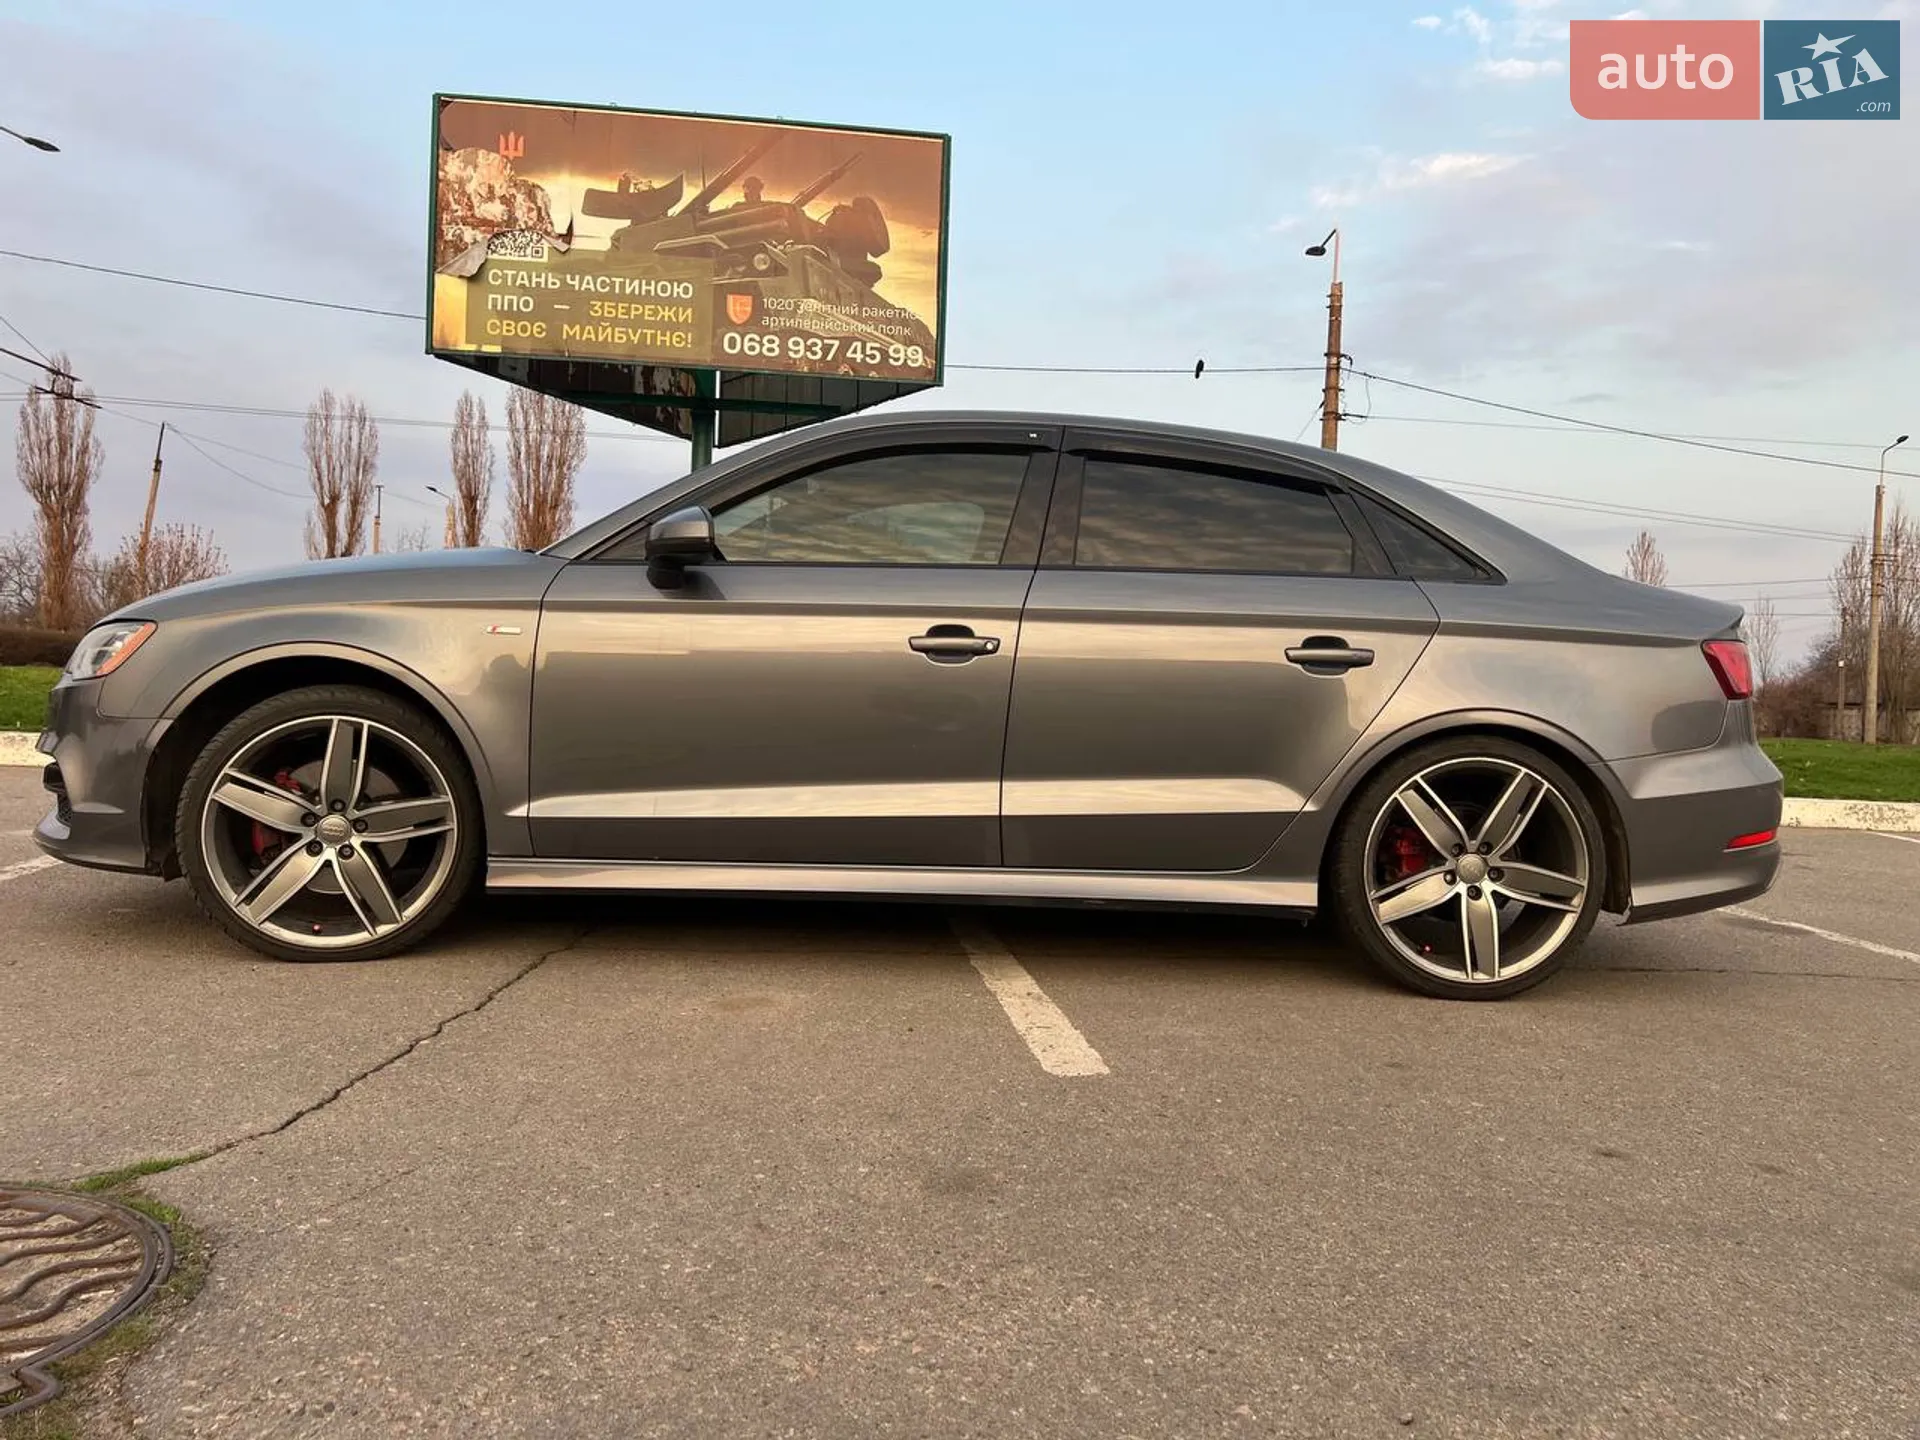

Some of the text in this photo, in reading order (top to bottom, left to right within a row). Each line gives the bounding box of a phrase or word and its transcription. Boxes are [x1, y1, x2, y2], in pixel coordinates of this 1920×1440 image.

[488, 268, 694, 298] СТАНЬ ЧАСТИНОЮ
[487, 294, 534, 312] ППО
[589, 301, 693, 324] ЗБЕРЕЖИ
[762, 298, 794, 311] 1020
[796, 300, 859, 317] зенітний
[486, 319, 692, 348] СВОЄ МАЙБУТНЄ!
[761, 315, 912, 336] артилерійський полк
[723, 332, 923, 367] 068 937 45 99
